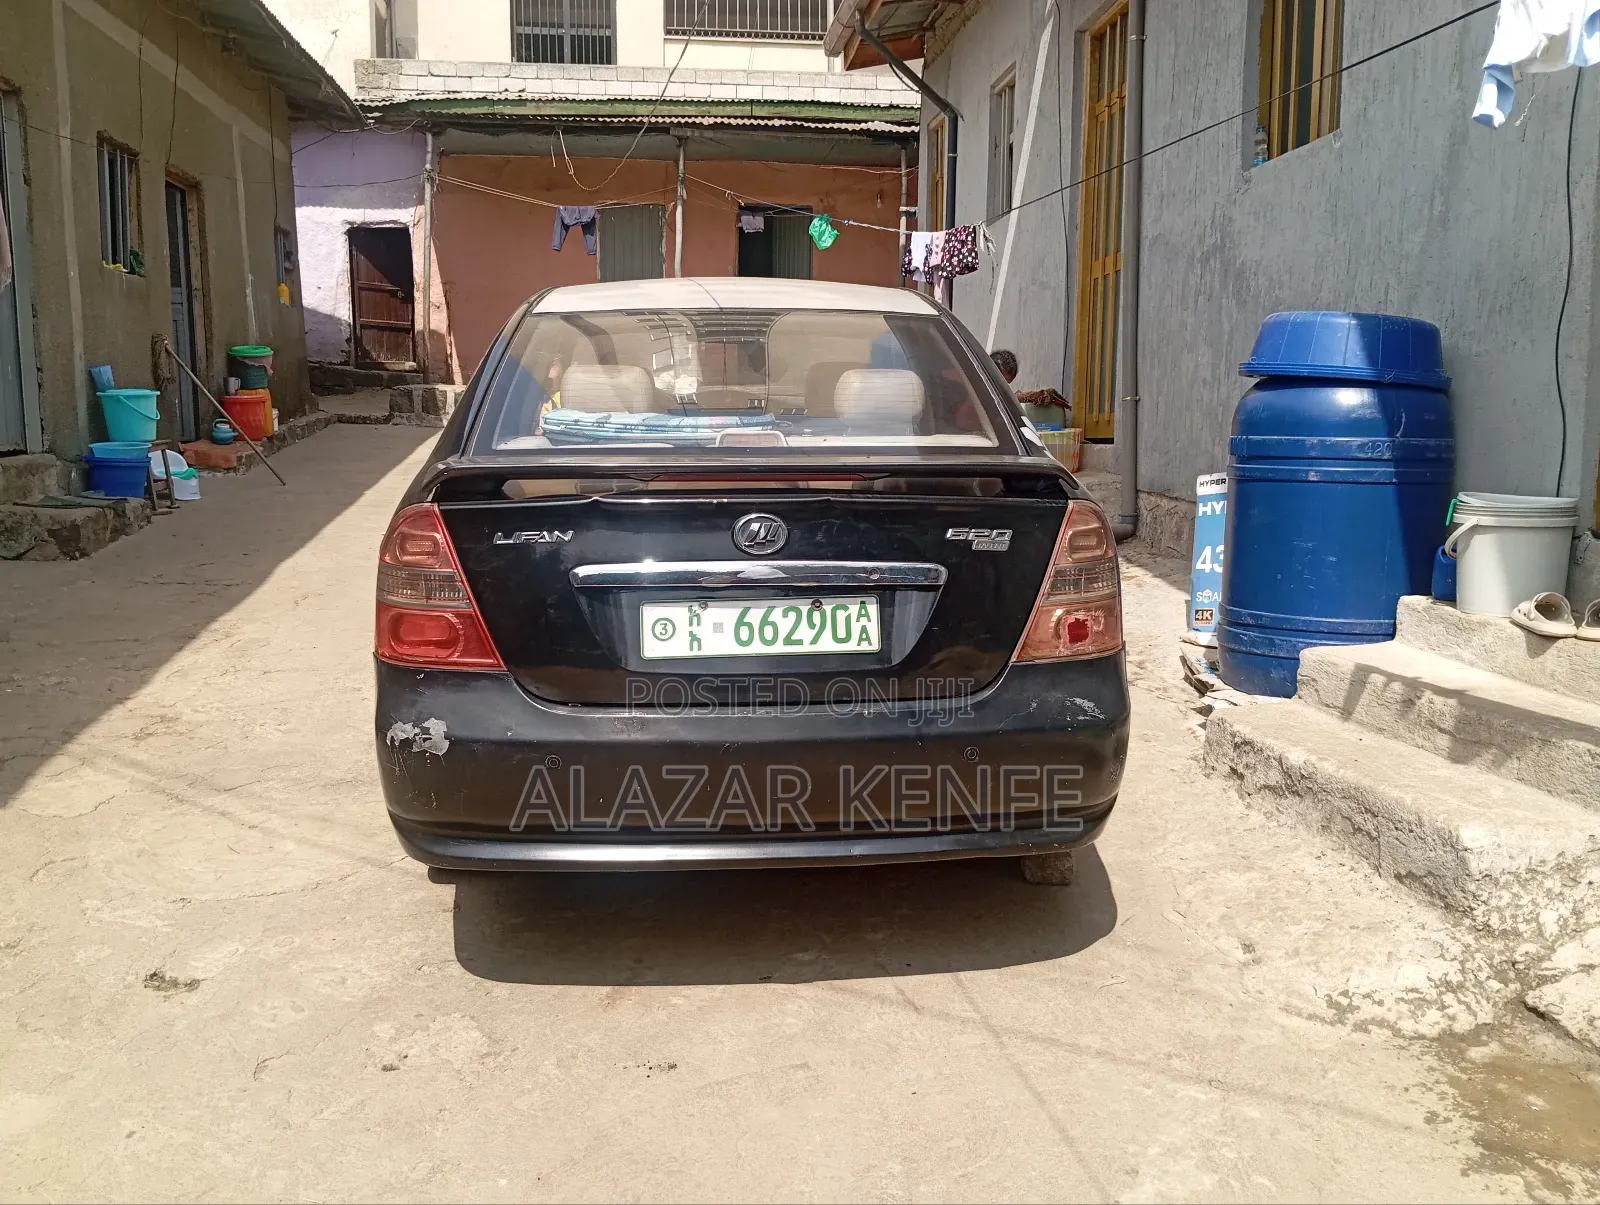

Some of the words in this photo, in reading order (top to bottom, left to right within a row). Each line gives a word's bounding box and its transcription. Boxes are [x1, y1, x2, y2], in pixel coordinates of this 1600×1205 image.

[1364, 442, 1392, 457] 420
[1199, 479, 1227, 487] HYPER
[1198, 501, 1227, 516] HY
[493, 530, 575, 544] LIFAN
[945, 527, 1013, 541] 620
[1195, 545, 1225, 573] 43
[1195, 589, 1222, 604] SMA
[1196, 610, 1213, 620] 4K
[733, 603, 852, 647] 66290
